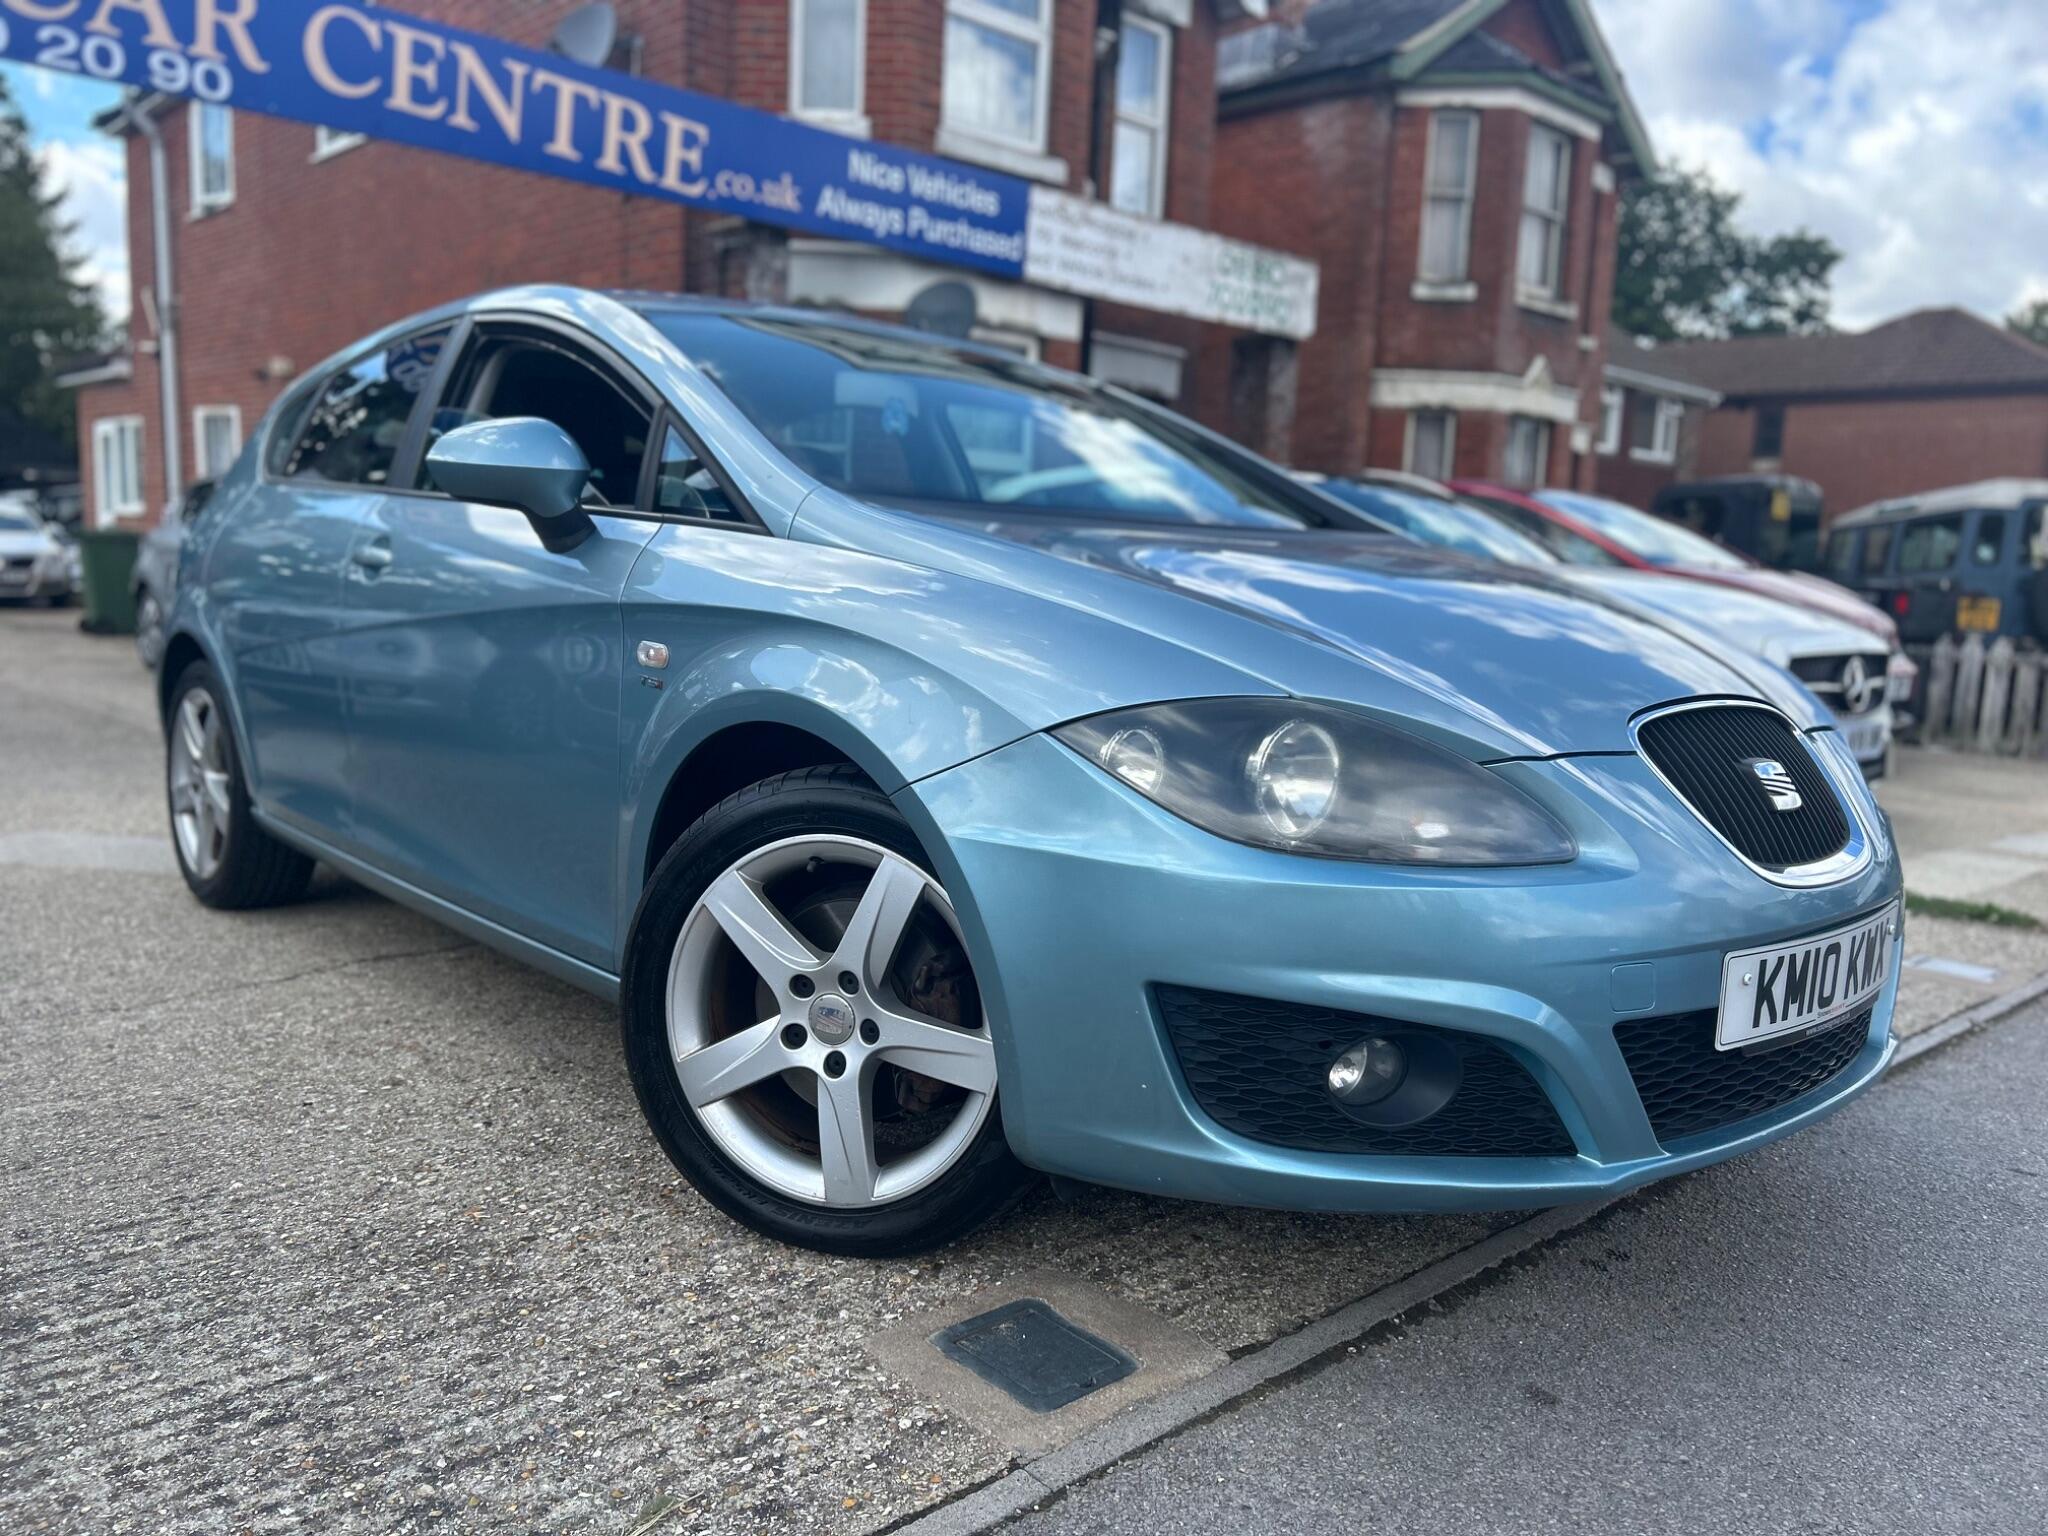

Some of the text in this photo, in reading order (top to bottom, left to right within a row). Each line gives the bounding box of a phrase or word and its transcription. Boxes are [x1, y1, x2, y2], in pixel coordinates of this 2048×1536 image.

[35, 24, 128, 80] 20
[147, 49, 234, 103] 90
[848, 148, 1001, 218] Nice Vehicles
[815, 184, 907, 239] Always
[907, 205, 1024, 263] Purchased
[1752, 916, 1890, 1029] KM10 KWX
